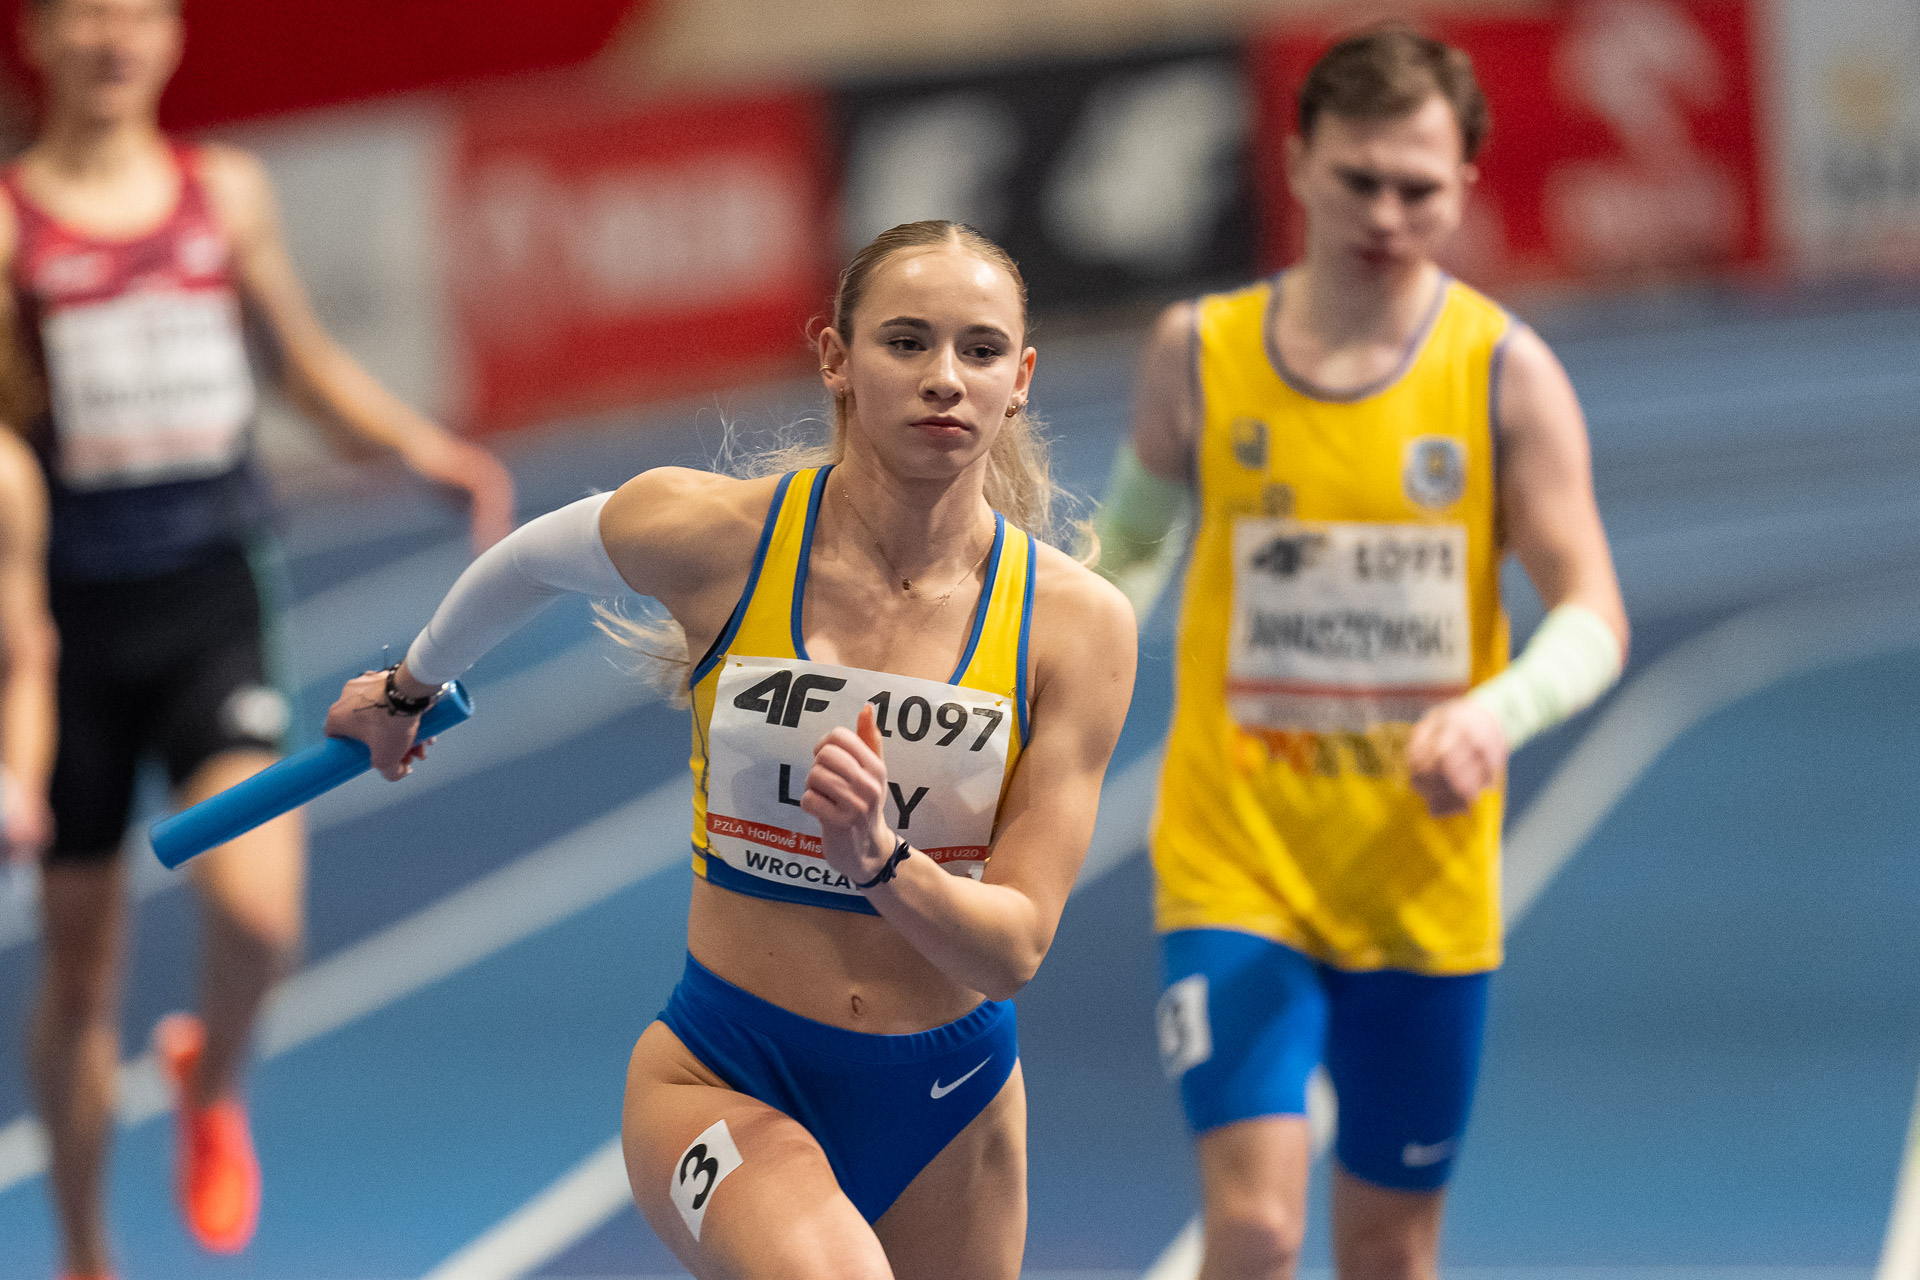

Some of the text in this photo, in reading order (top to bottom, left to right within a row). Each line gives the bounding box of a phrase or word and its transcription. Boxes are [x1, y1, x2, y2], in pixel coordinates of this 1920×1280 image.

[733, 669, 847, 728] 4F
[867, 690, 1004, 752] 1097
[778, 763, 930, 830] LY
[713, 819, 744, 834] PZLA
[952, 848, 979, 858] U20
[745, 849, 860, 891] WROCŁA
[680, 1143, 719, 1211] 3
